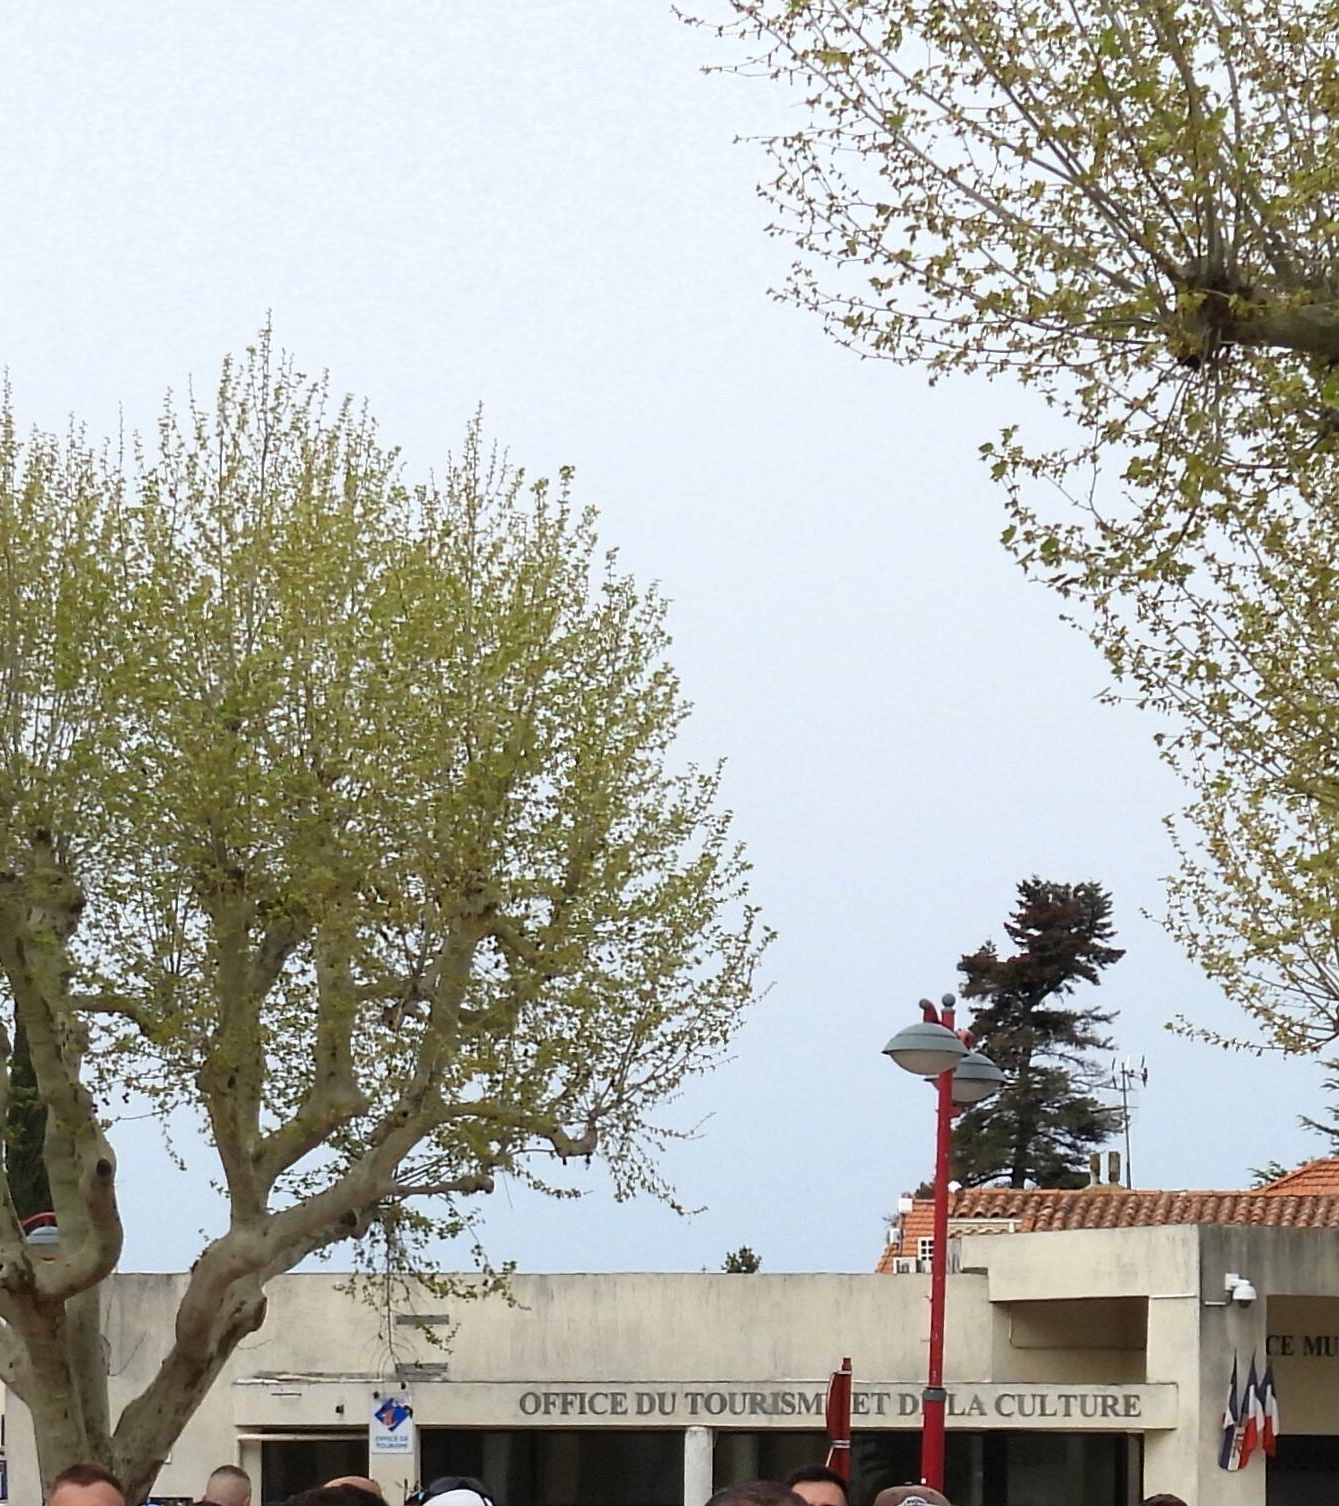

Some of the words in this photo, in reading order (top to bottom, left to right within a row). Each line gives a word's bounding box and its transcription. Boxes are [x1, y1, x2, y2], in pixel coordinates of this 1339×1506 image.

[519, 1391, 628, 1416] OFFICE
[634, 1391, 676, 1416] DU
[684, 1391, 824, 1416] TOURISM
[851, 1391, 891, 1416] ET
[897, 1391, 925, 1417] D
[947, 1391, 988, 1417] LA
[994, 1392, 1142, 1418] CULTURE
